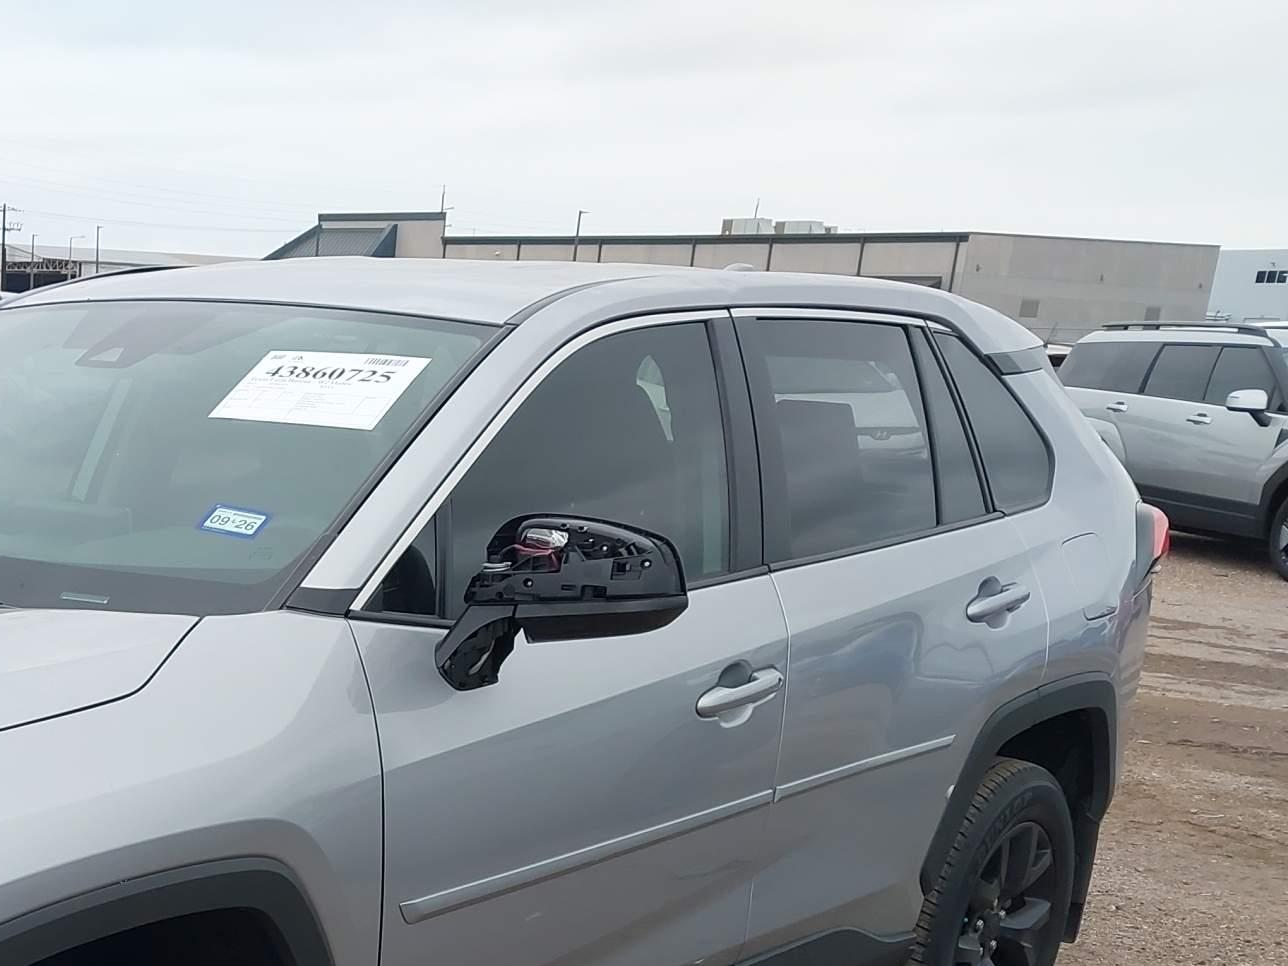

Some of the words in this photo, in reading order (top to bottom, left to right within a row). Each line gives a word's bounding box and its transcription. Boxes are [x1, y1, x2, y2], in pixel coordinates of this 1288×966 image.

[265, 364, 397, 383] 43860725
[209, 514, 231, 526] 09
[234, 519, 257, 531] 26
